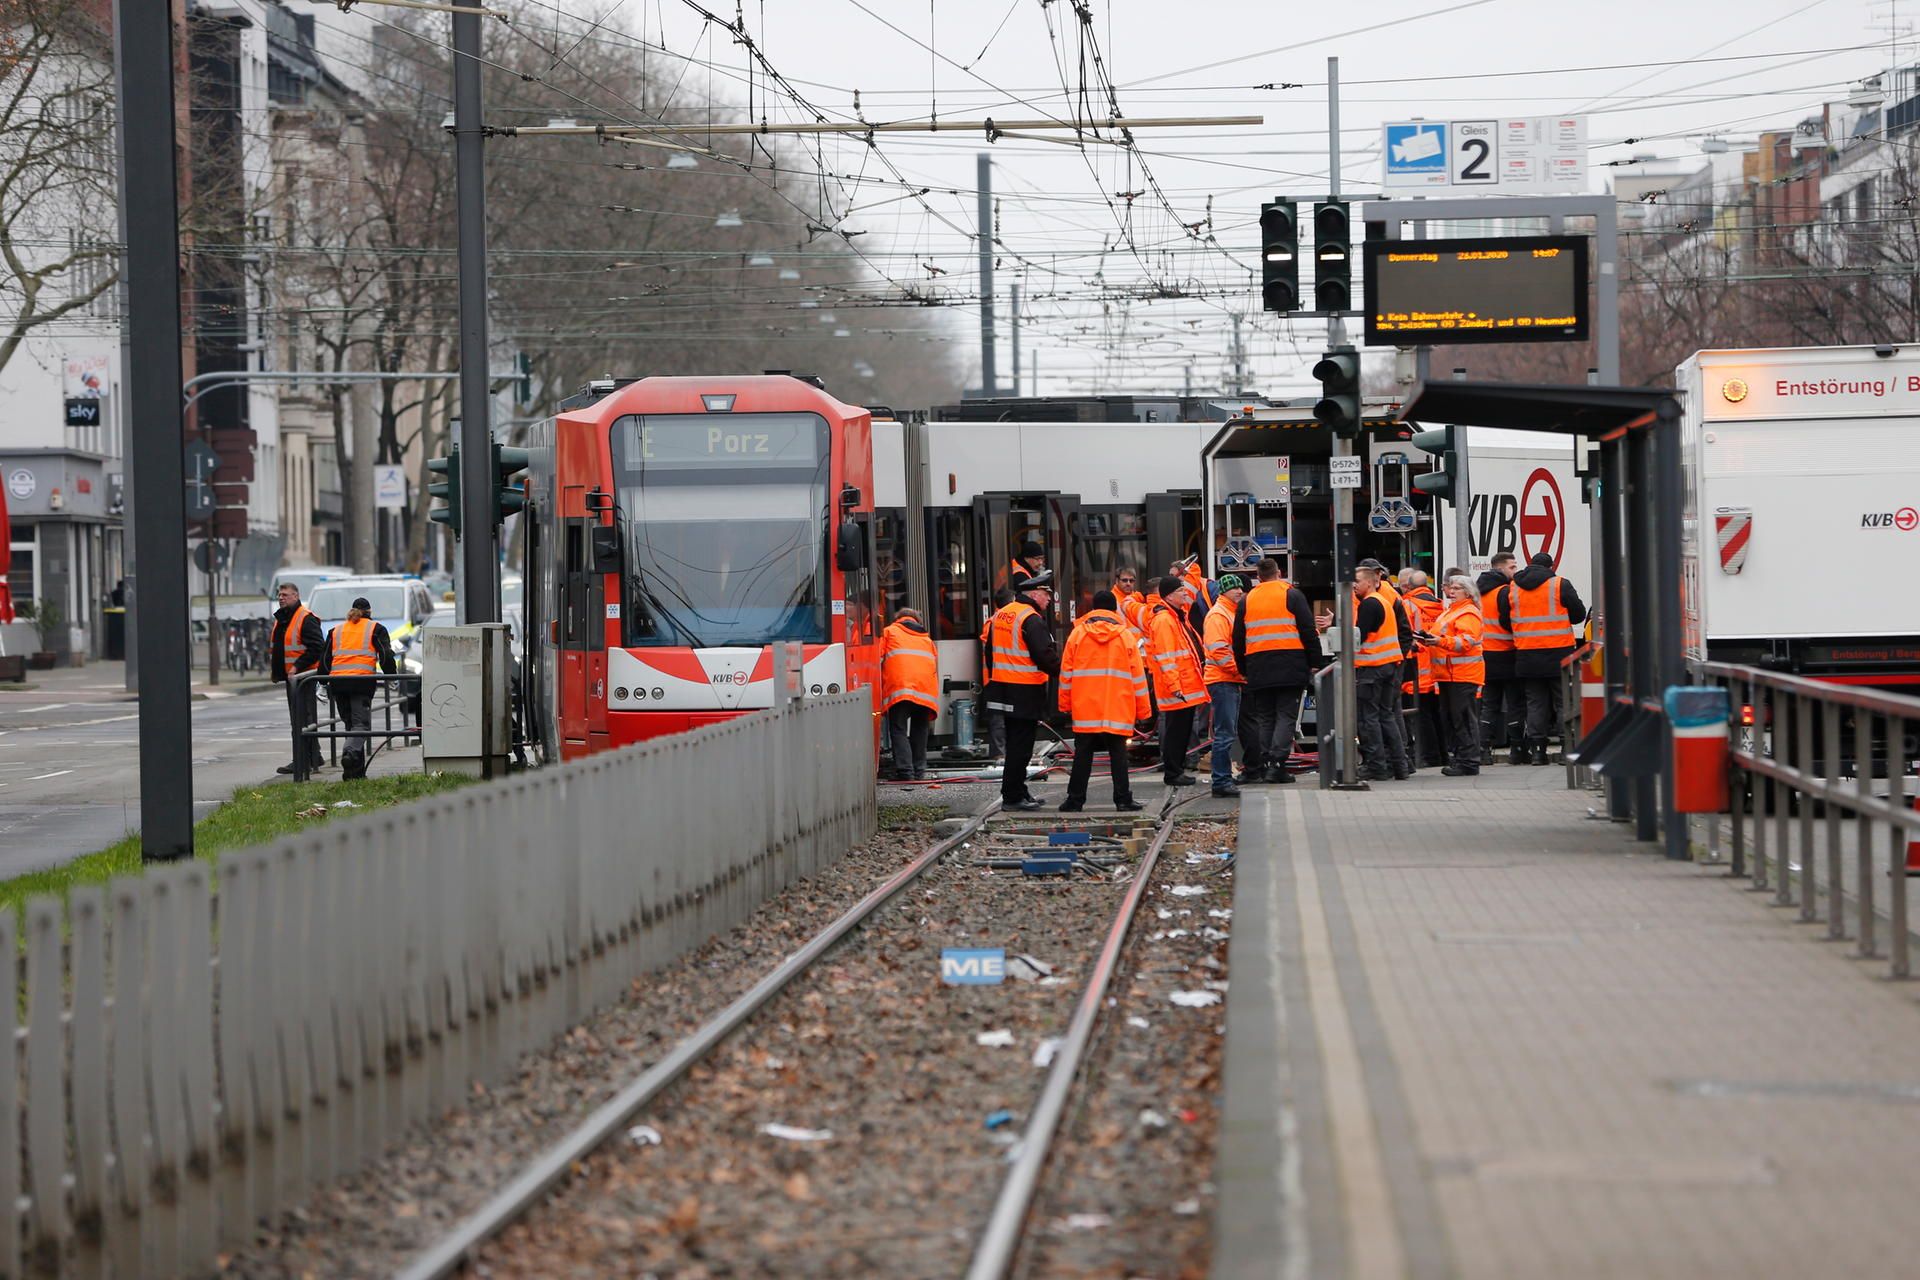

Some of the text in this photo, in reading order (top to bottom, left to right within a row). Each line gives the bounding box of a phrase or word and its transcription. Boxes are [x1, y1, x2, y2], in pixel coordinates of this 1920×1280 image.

[1461, 125, 1488, 136] Gleis
[1461, 139, 1490, 180] 2
[1388, 253, 1438, 262] Donnerstag
[1387, 312, 1464, 321] Kein Bahnverkehr
[1497, 318, 1514, 327] und
[1776, 378, 1885, 397] Entstörung
[69, 404, 96, 420] sky
[643, 426, 769, 458] E Porz
[1468, 494, 1518, 557] KVB
[1861, 513, 1894, 527] KVB
[712, 674, 733, 683] KVB
[943, 957, 1004, 977] ME
